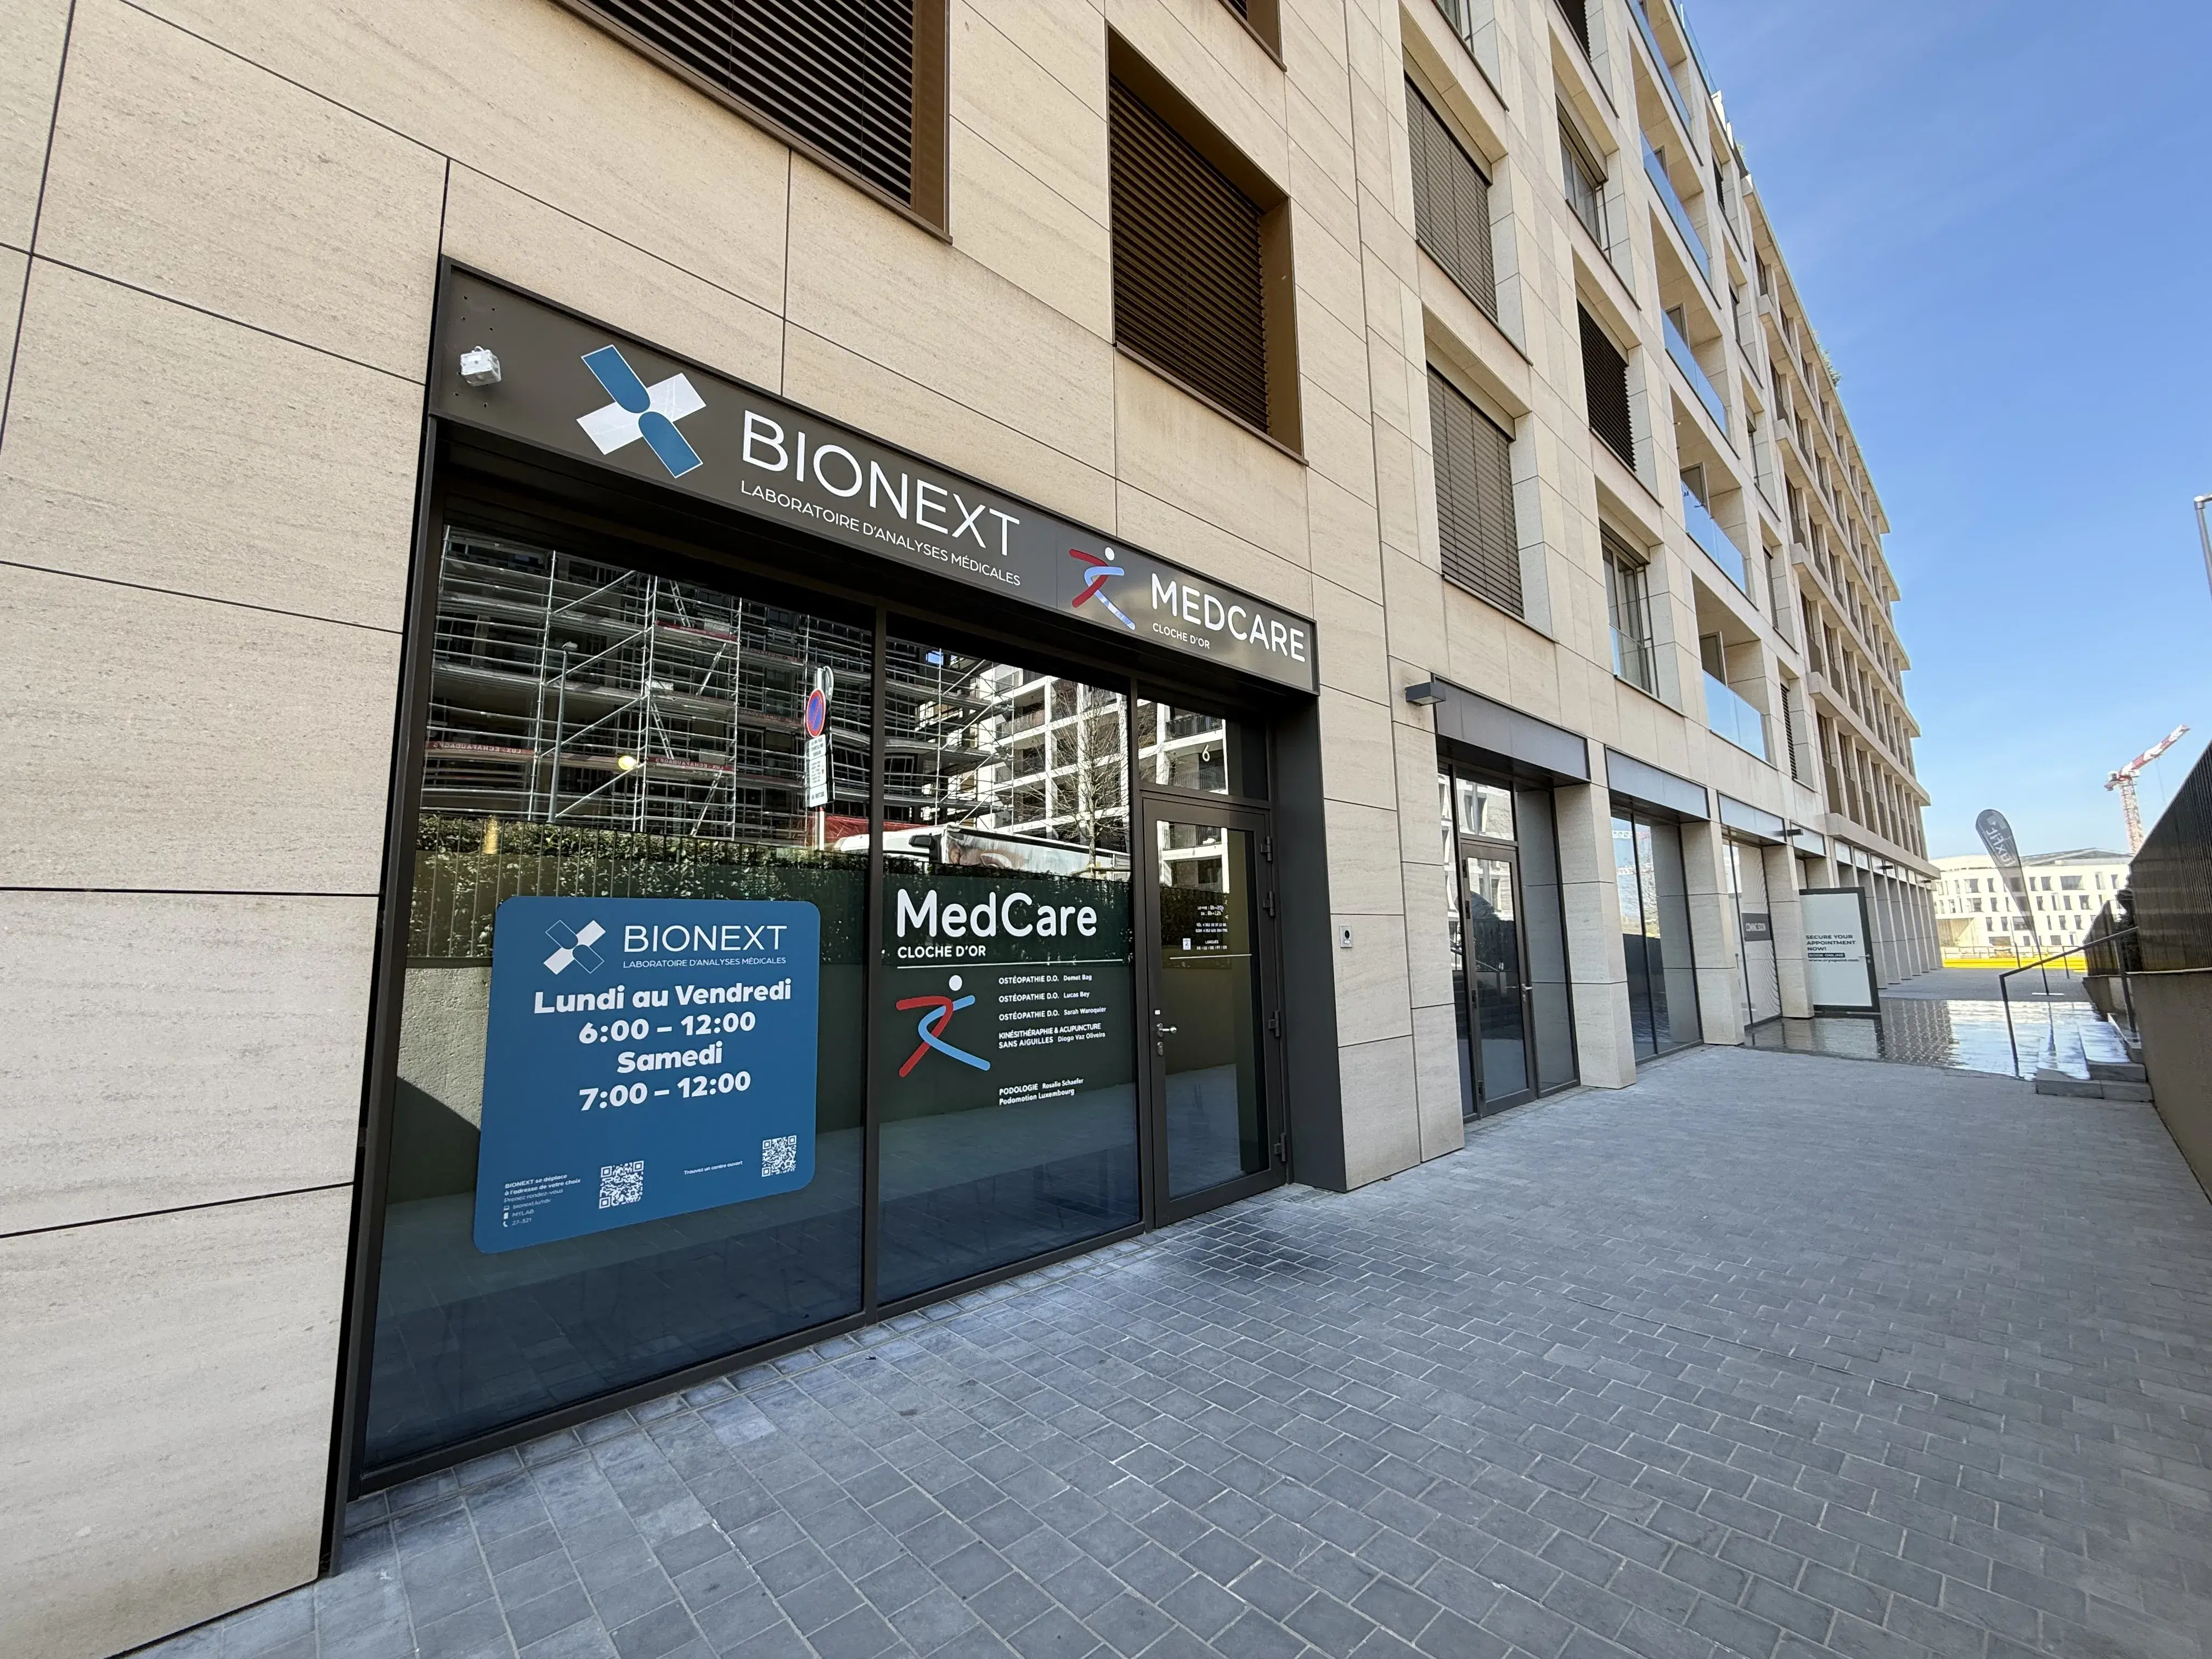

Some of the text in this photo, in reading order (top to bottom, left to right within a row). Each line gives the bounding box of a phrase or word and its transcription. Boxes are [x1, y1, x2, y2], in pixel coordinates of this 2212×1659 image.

[742, 409, 1020, 556] BIONEXT
[741, 479, 1021, 586] LABORATOIRE D'ANALYSES MÉDICALES
[1151, 572, 1306, 663] MEDCARE
[1152, 622, 1210, 650] CLOCHE D'OR
[1202, 744, 1210, 762] 6
[897, 888, 1097, 938] MedCare
[623, 924, 787, 952] BIONEXT
[897, 944, 986, 959] CLOCHE D'OR
[623, 956, 787, 968] LABORATOIRE D'ANALYSES MÉDICALES
[998, 975, 1045, 984] OSTÉOPATHIE
[534, 978, 792, 1014] Lundi au Vendredi
[998, 992, 1045, 1003] OSTÉOPATHIE
[998, 1011, 1046, 1021] OSTÉOPATHIE
[1080, 1006, 1107, 1014] Waroquier
[579, 1018, 650, 1045] 6:00
[681, 1011, 756, 1036] 12:00
[1059, 1023, 1102, 1034] ACUPUNCTURE
[998, 1040, 1018, 1049] SANS
[1019, 1036, 1054, 1047] AIGUILLES
[1086, 1031, 1106, 1039] Oliveira
[617, 1041, 724, 1074] Samedi
[579, 1082, 648, 1111] 7:00
[677, 1070, 751, 1098] 12:00
[998, 1077, 1084, 1096] PODOLOGIE Rosalie Schaefer
[998, 1088, 1075, 1106] Podomotion Luxembourg
[505, 1179, 534, 1189] BIONEXT
[543, 1174, 568, 1183] déplace
[527, 1188, 564, 1199] rendez-vous
[512, 1209, 534, 1217] MYLAB
